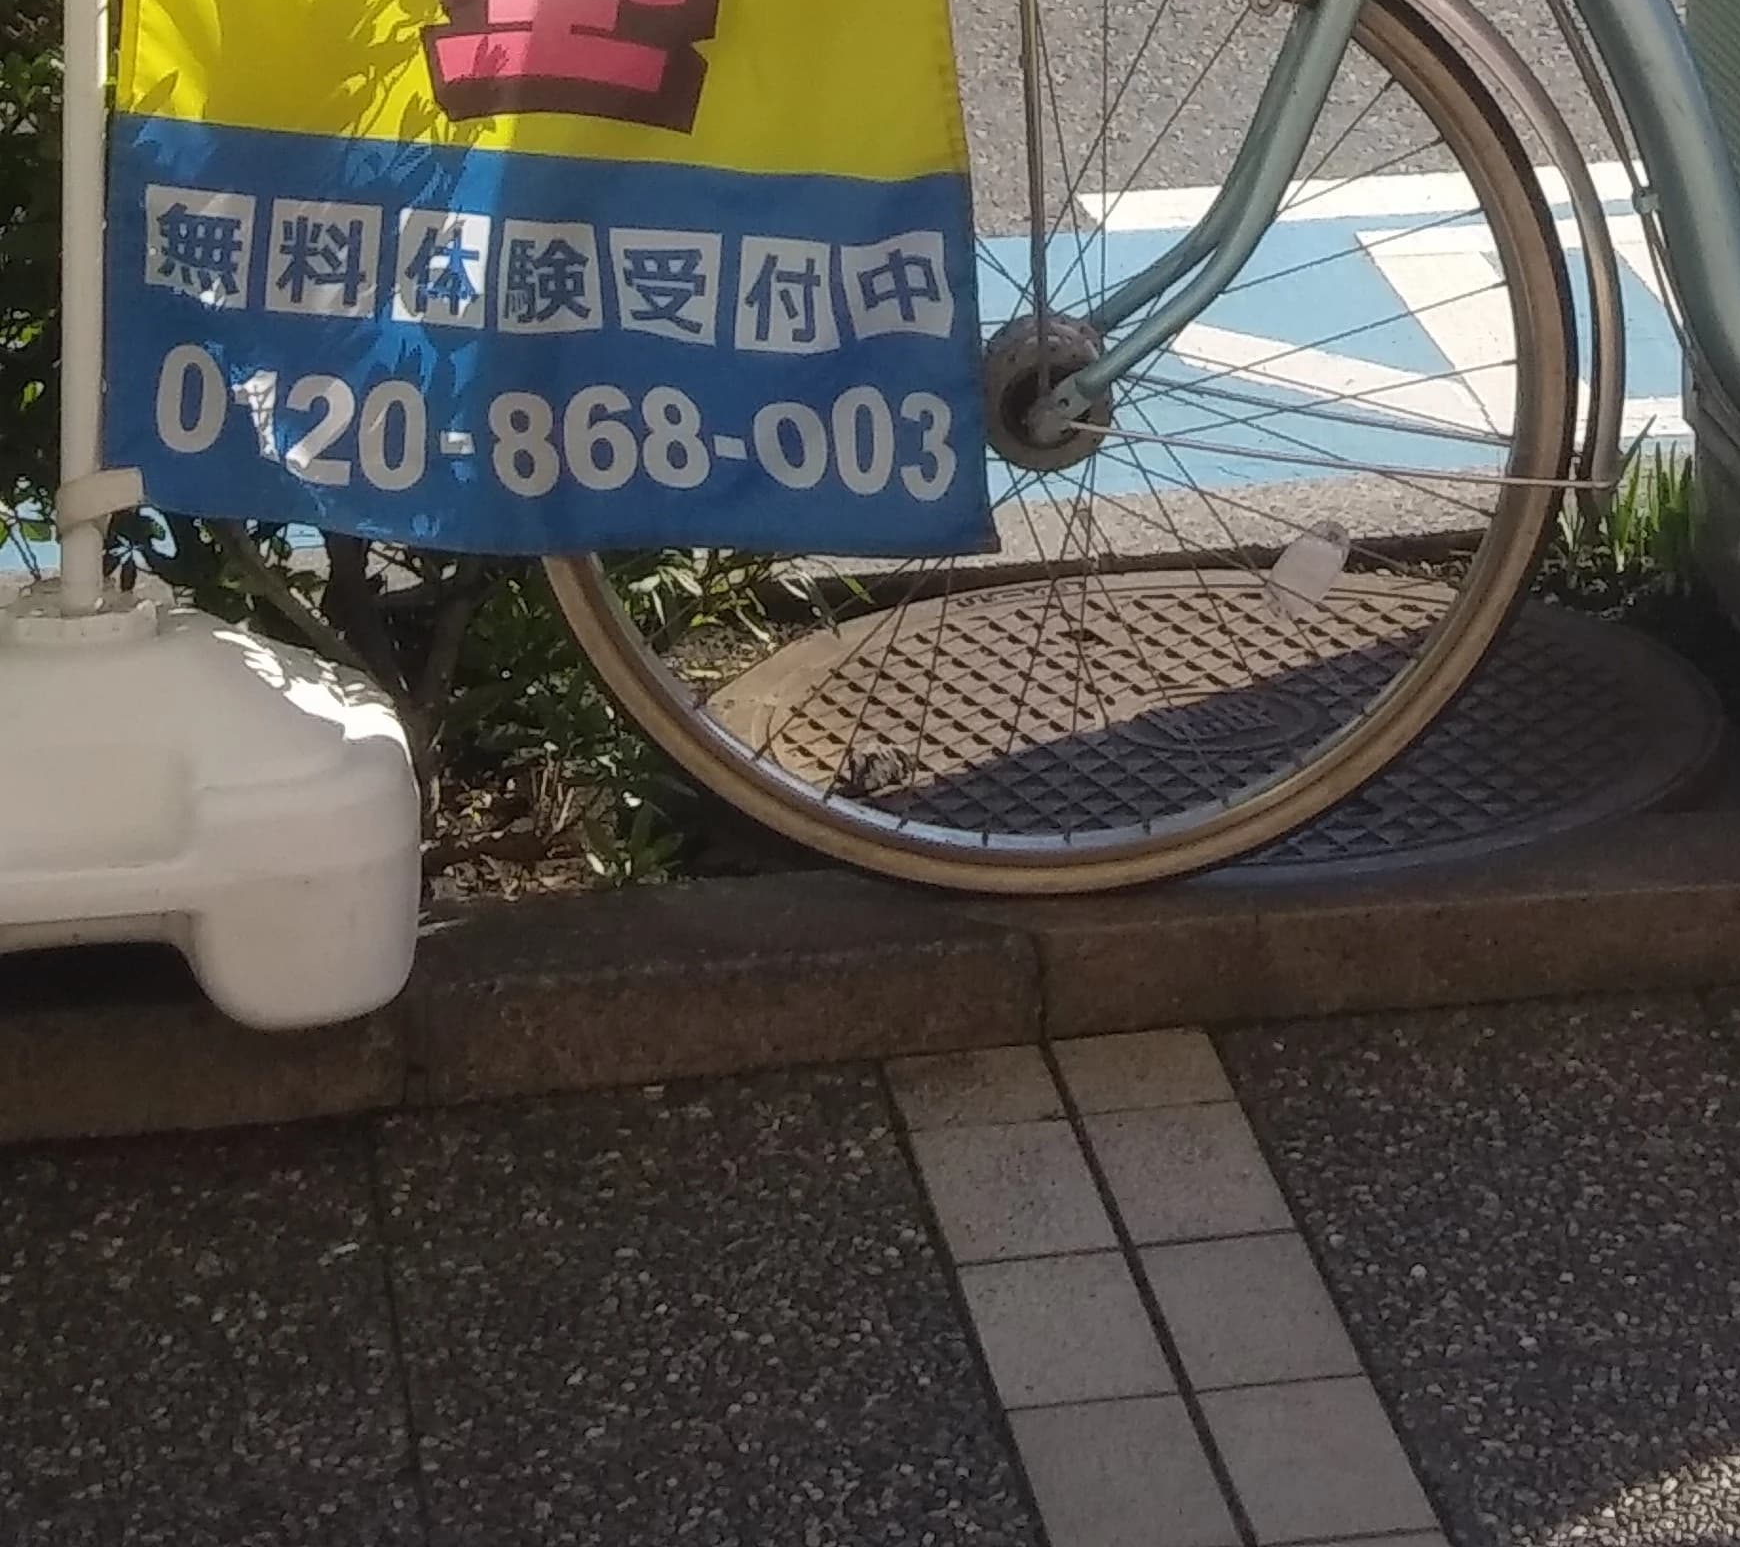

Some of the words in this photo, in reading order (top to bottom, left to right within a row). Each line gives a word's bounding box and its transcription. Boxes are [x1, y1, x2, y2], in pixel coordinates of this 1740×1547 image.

[152, 201, 944, 345] 無料体験受付中
[155, 344, 957, 503] 0120-868-003
